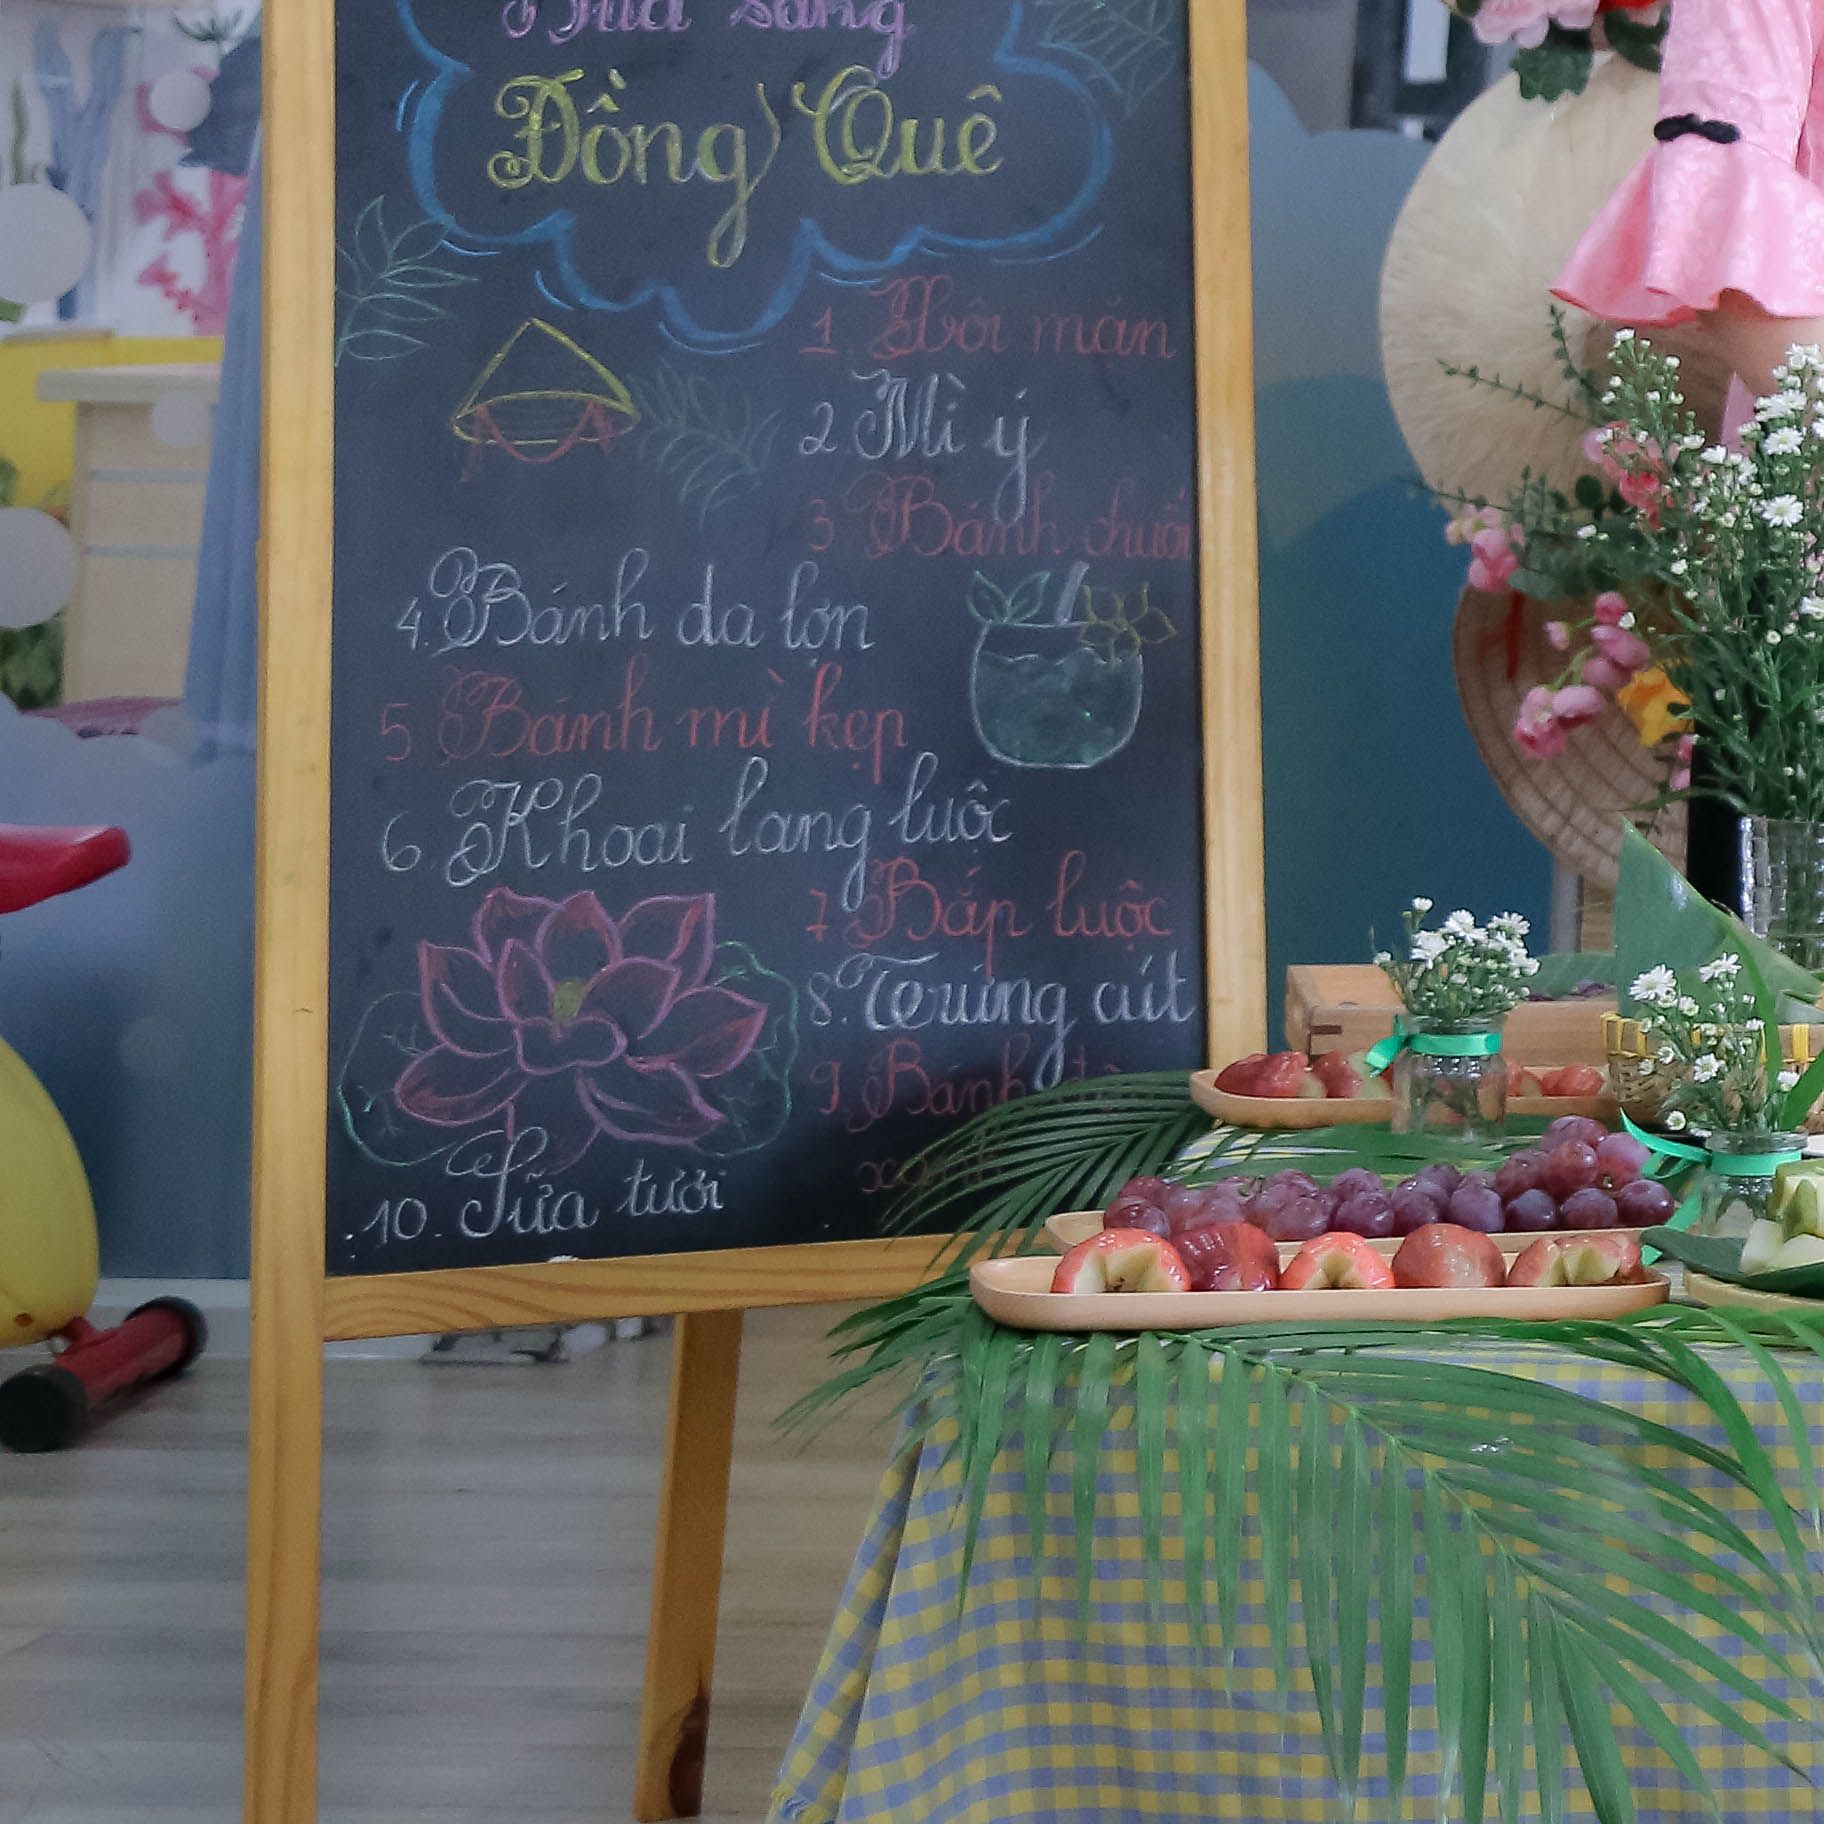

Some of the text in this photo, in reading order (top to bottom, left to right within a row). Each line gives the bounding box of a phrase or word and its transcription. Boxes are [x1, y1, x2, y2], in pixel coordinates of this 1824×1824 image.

[487, 65, 1004, 268] Đồng Quê
[851, 368, 966, 460] Mì
[430, 547, 653, 657] Bánh
[677, 563, 765, 648] da
[783, 561, 876, 667] lợn
[438, 653, 662, 766] Bánh
[678, 668, 787, 750] mì
[447, 773, 695, 887] Khoai
[719, 754, 872, 913] lang
[1093, 949, 1198, 1025] cút
[617, 1158, 729, 1217] tươi
